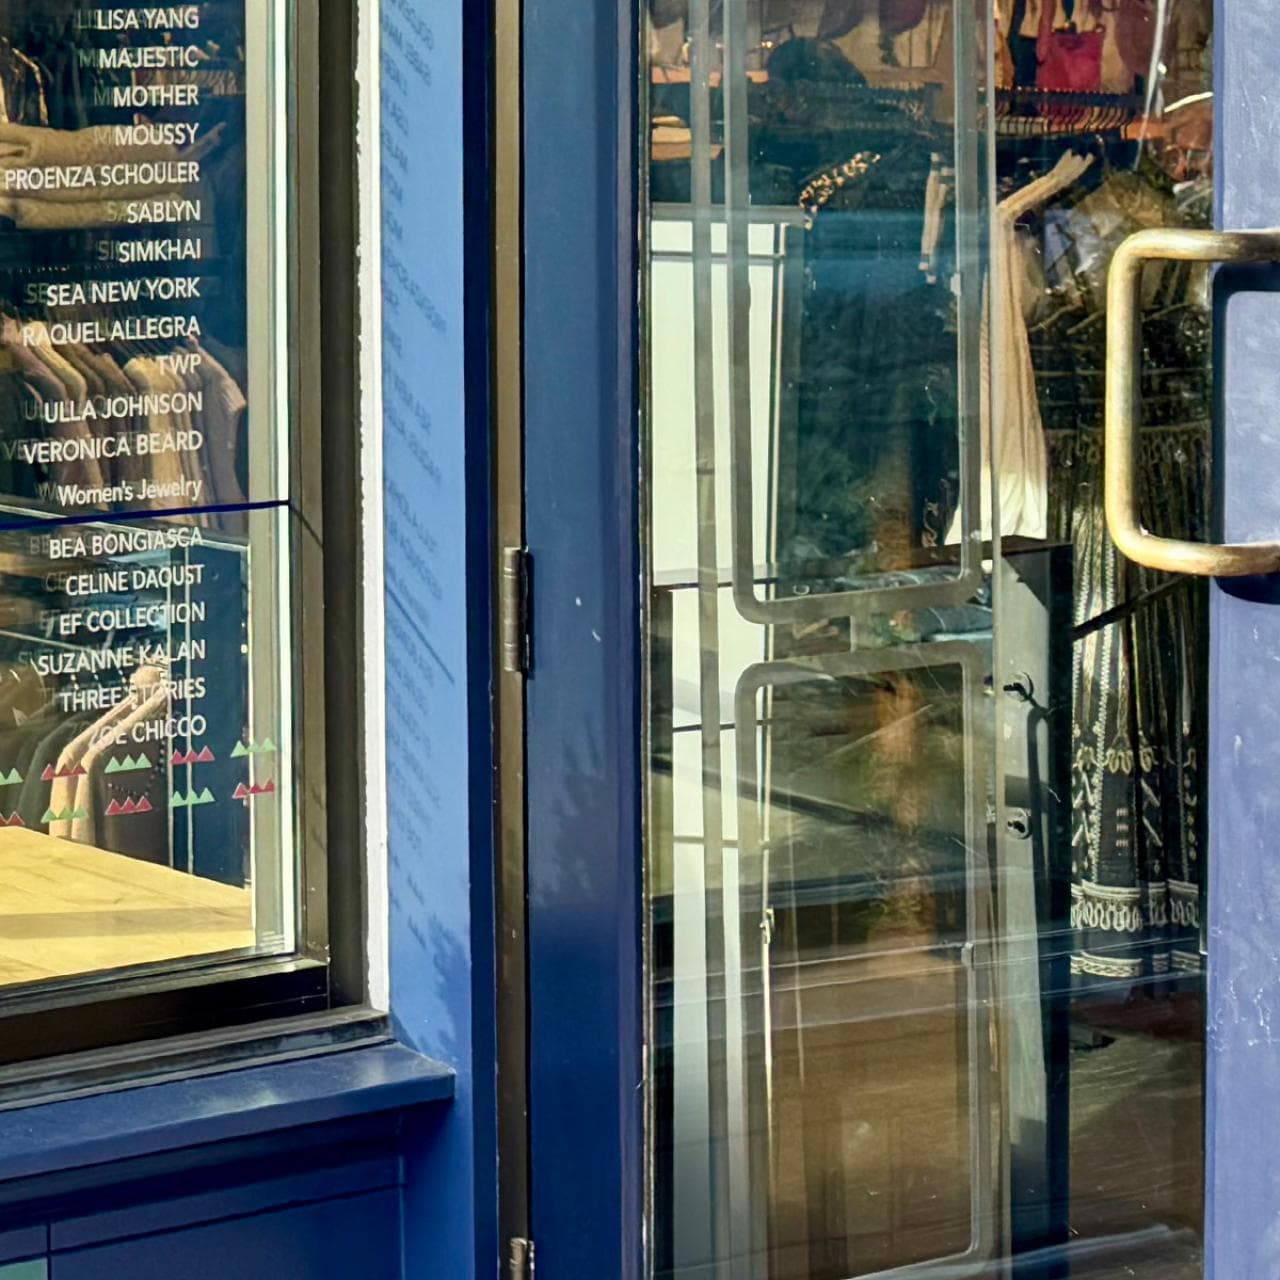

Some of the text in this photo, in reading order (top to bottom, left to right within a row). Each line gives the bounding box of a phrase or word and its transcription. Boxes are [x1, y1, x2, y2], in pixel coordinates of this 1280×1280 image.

[97, 7, 199, 30] LISA YANG
[99, 45, 199, 69] MAJESTIC
[113, 85, 199, 108] MOTHER
[115, 124, 199, 146] MOUSSY
[5, 162, 199, 191] PROENZA SCHOULER
[127, 200, 200, 223] SABLYN
[118, 239, 201, 263] SIMKHAI
[47, 277, 200, 307] SEA NEW YORK
[21, 316, 201, 347] RAQUEL ALLEGRA
[157, 355, 201, 375] TWP
[44, 392, 203, 424] ULLA JOHNSON
[24, 431, 203, 464] VERONICA BEARD
[58, 476, 202, 507] Women's Jewelry
[49, 527, 203, 560] BEA BONGIASCA
[66, 565, 204, 596] CELINE DAOUST
[60, 603, 205, 636] EF COLLECTION
[38, 640, 206, 677] SUZANNE KALAN
[59, 688, 121, 714] THREE
[131, 716, 206, 744] CHICCO
